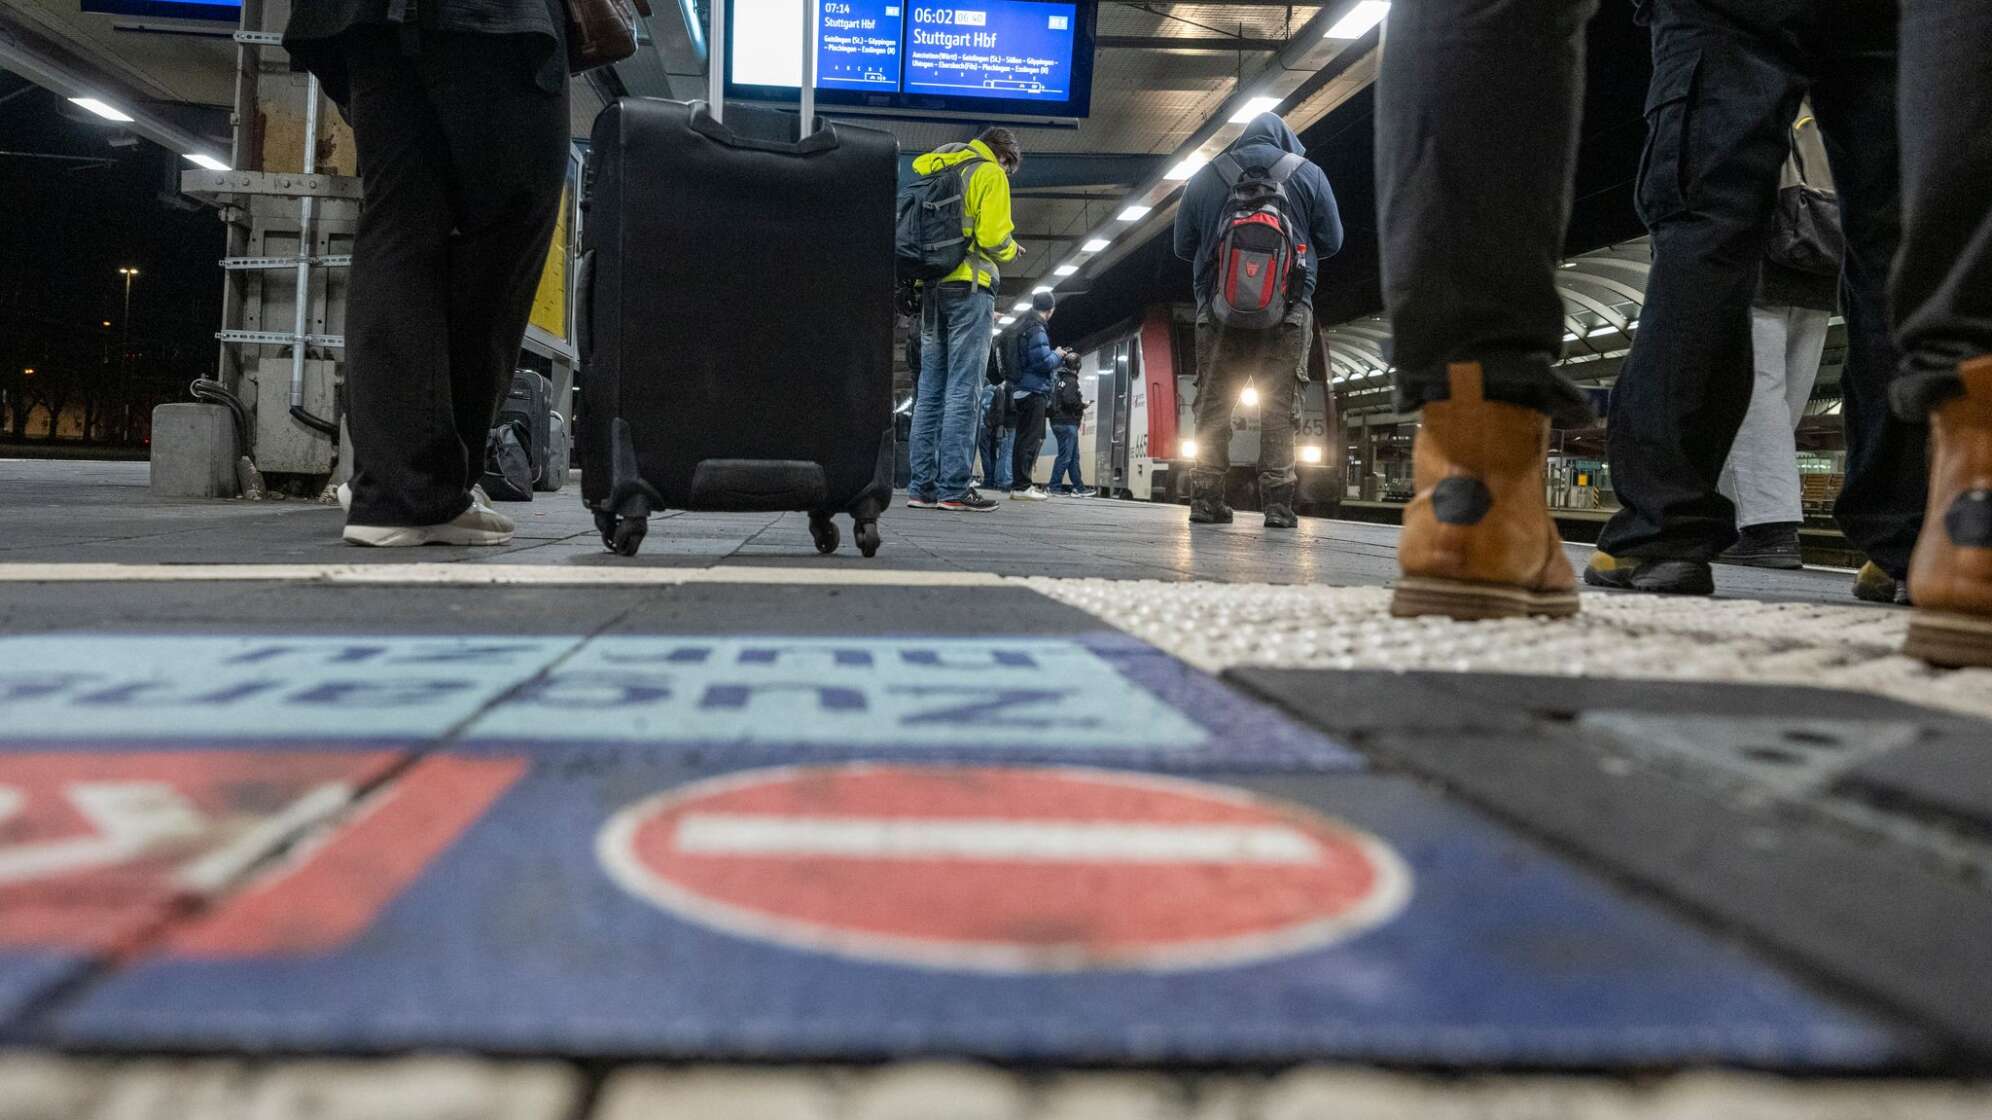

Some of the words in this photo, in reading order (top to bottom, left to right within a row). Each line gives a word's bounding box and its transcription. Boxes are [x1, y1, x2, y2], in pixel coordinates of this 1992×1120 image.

[825, 3, 850, 14] 07:14
[914, 8, 953, 24] 06:02
[825, 17, 860, 30] Stuttgart
[861, 19, 876, 29] Hbf
[913, 29, 971, 48] Stuttgart
[974, 32, 997, 48] Hbf
[218, 646, 542, 663] zu
[600, 646, 1036, 668] nur
